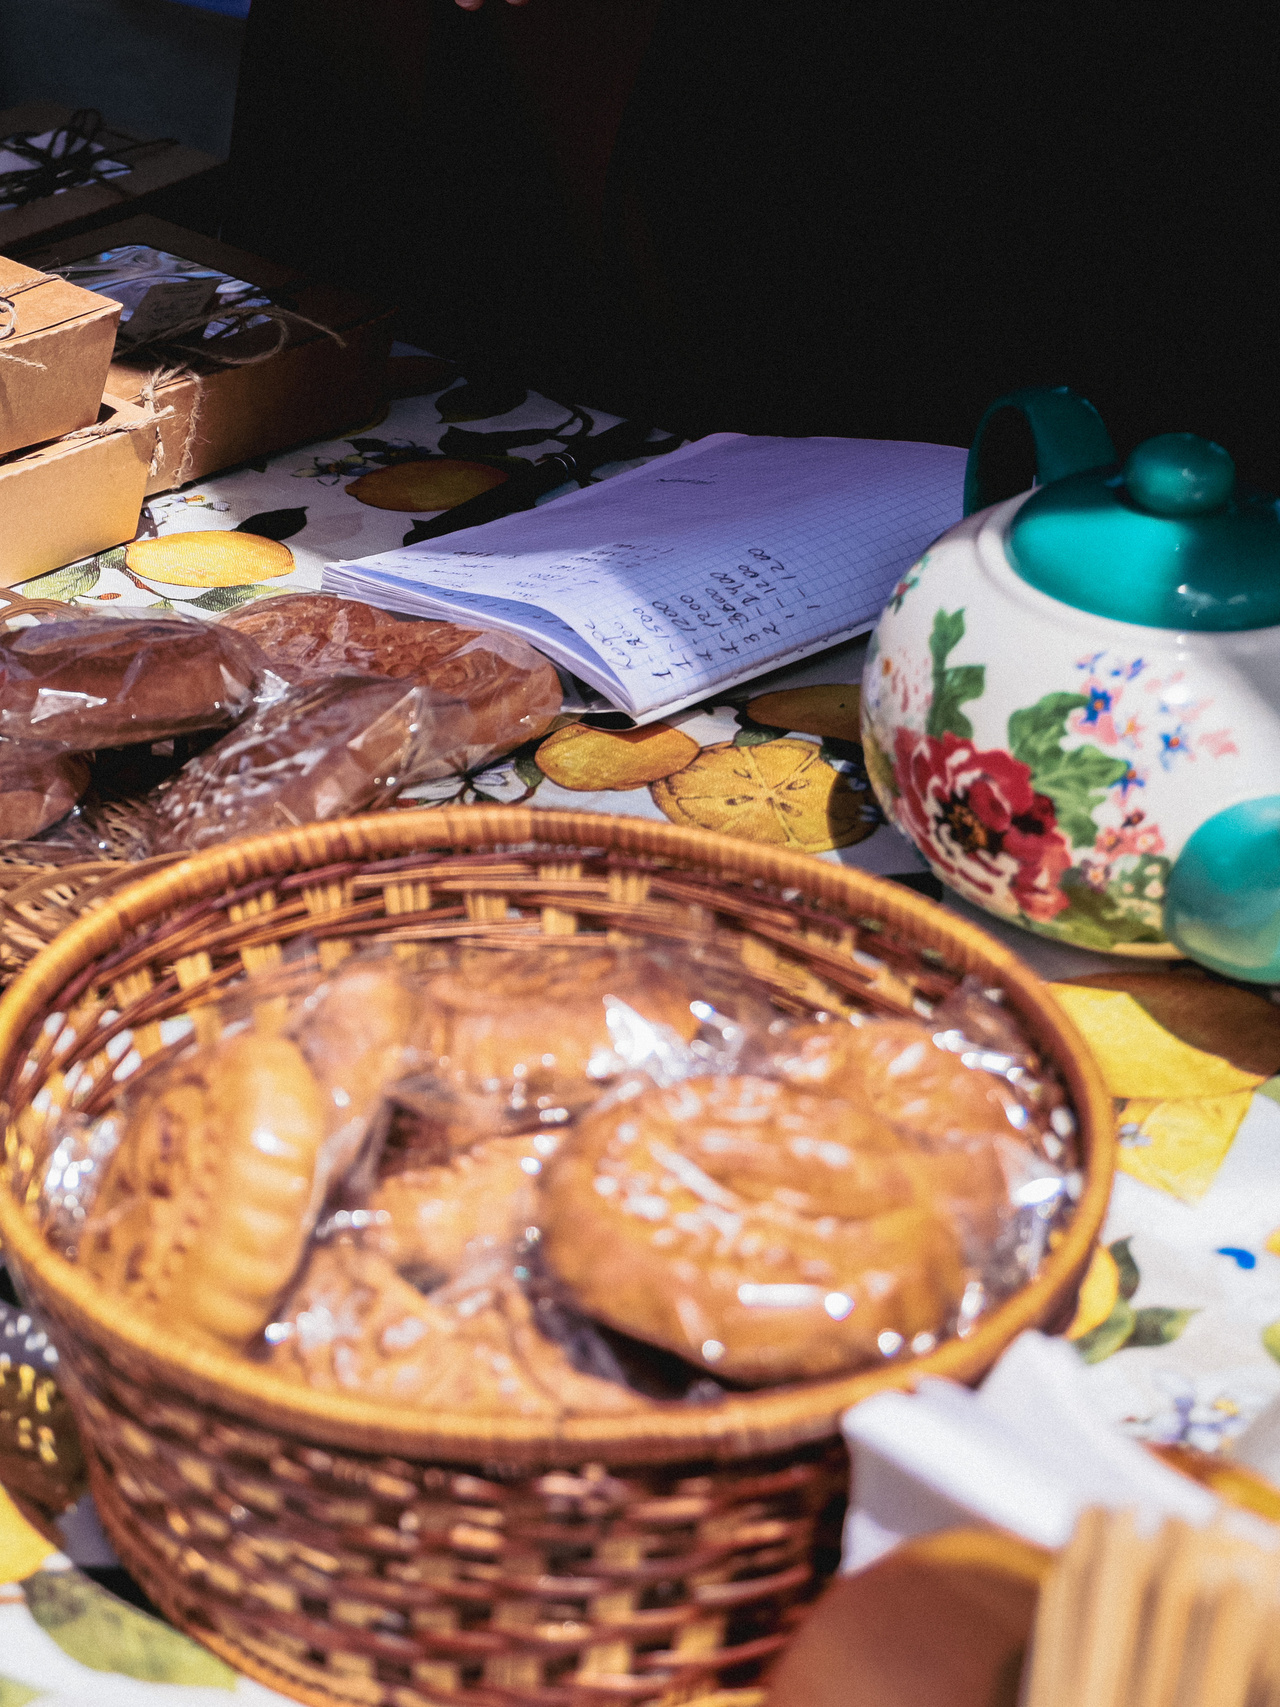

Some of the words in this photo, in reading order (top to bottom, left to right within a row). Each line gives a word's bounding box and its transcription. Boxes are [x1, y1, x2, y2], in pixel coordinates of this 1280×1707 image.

[737, 564, 777, 594] 1200
[747, 547, 797, 580] 1200
[632, 607, 670, 639] 1500
[651, 600, 698, 632] 1200
[680, 594, 723, 628] 1200
